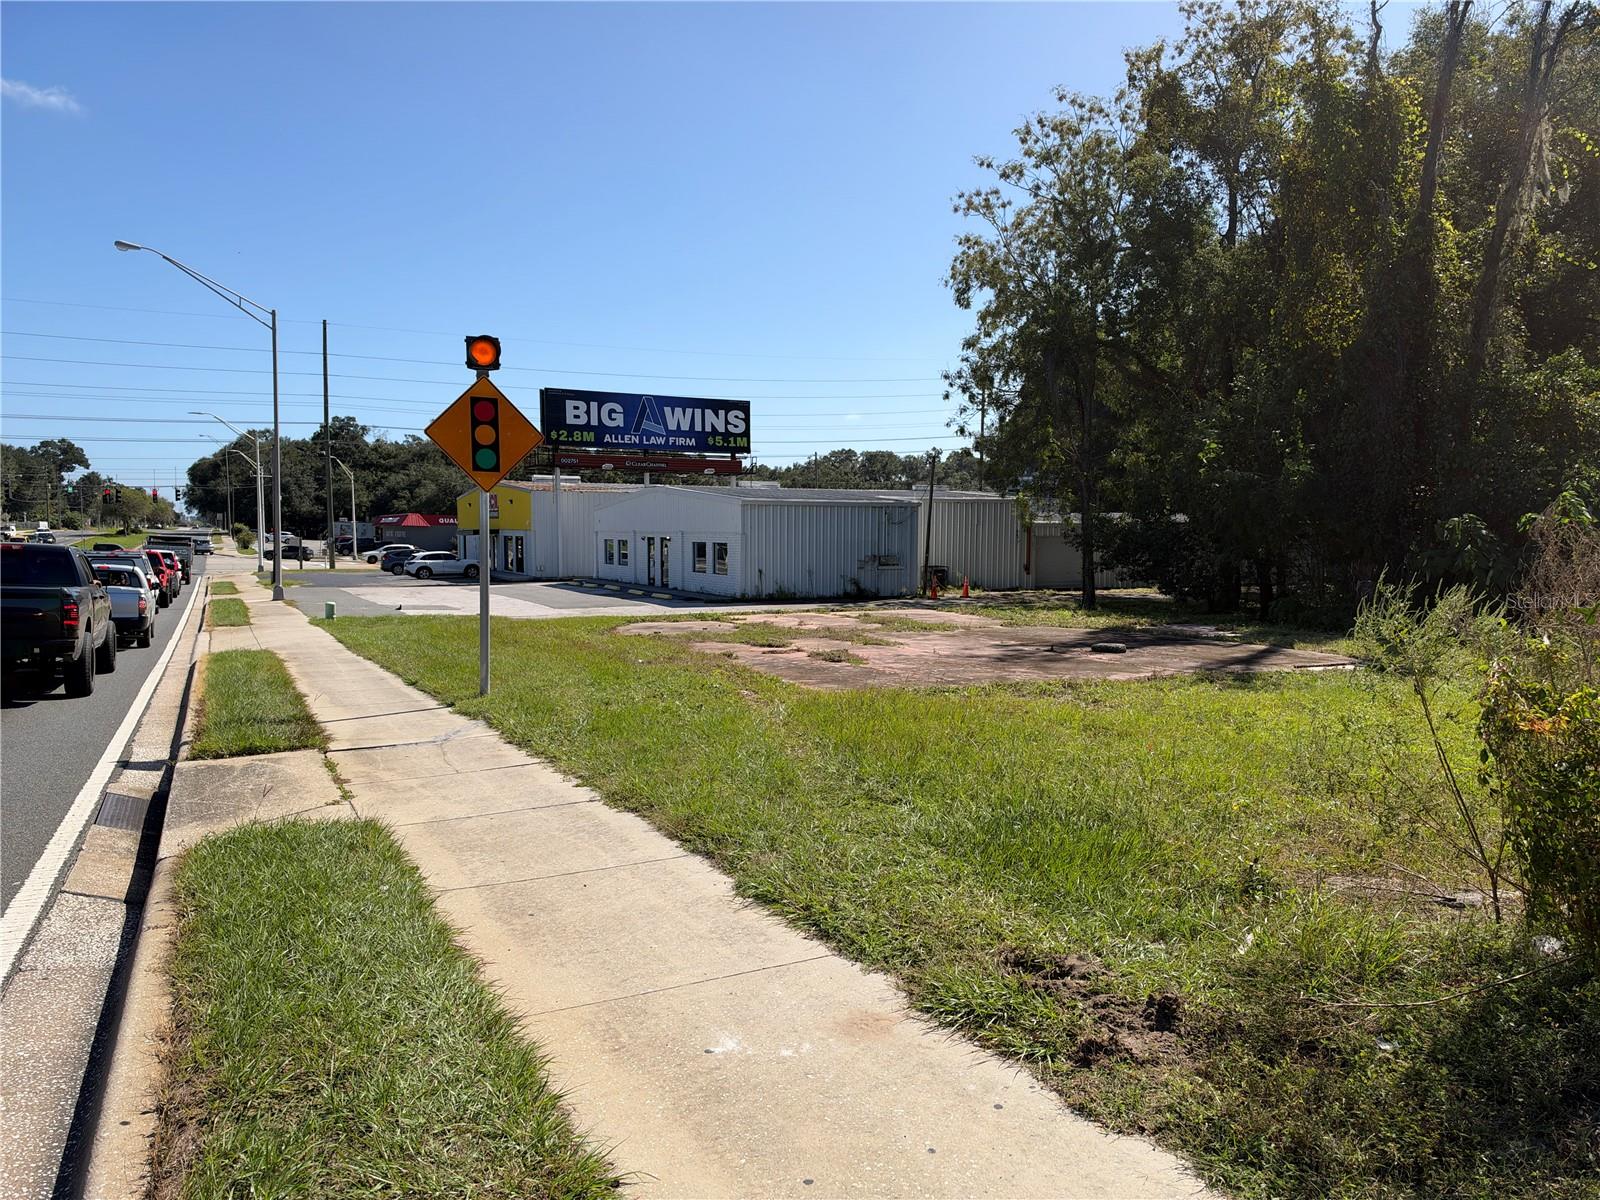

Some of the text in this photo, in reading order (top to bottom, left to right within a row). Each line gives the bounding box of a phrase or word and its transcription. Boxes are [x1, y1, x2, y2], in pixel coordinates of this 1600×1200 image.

[565, 400, 624, 427] BIG
[664, 407, 746, 434] WINS
[550, 430, 595, 442] $2.8M
[604, 434, 696, 447] ALLEN LAW FIRM
[707, 436, 748, 447] $5.1M
